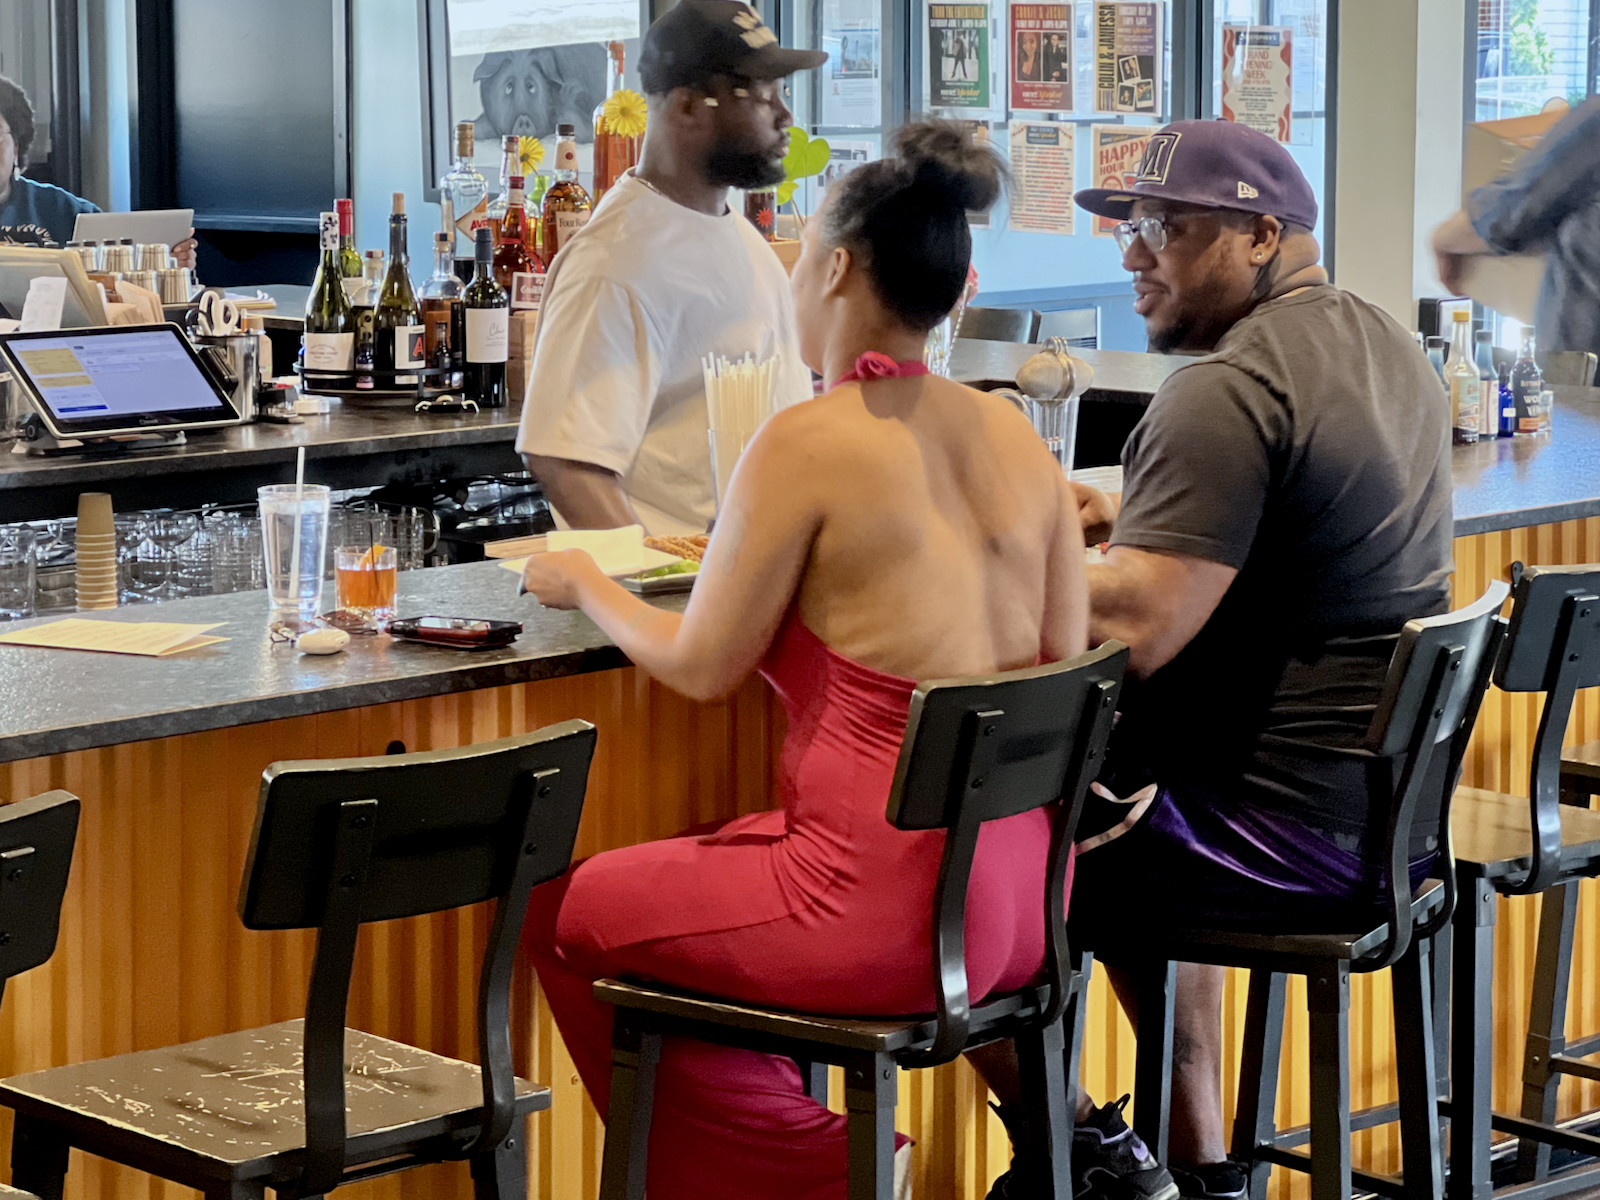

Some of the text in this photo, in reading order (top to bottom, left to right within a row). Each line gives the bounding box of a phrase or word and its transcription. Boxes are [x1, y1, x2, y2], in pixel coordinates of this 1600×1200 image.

[1245, 50, 1269, 60] RAND
[1098, 62, 1115, 89] COLIN
[1100, 139, 1148, 166] HAPPY
[1100, 161, 1126, 176] HOUR
